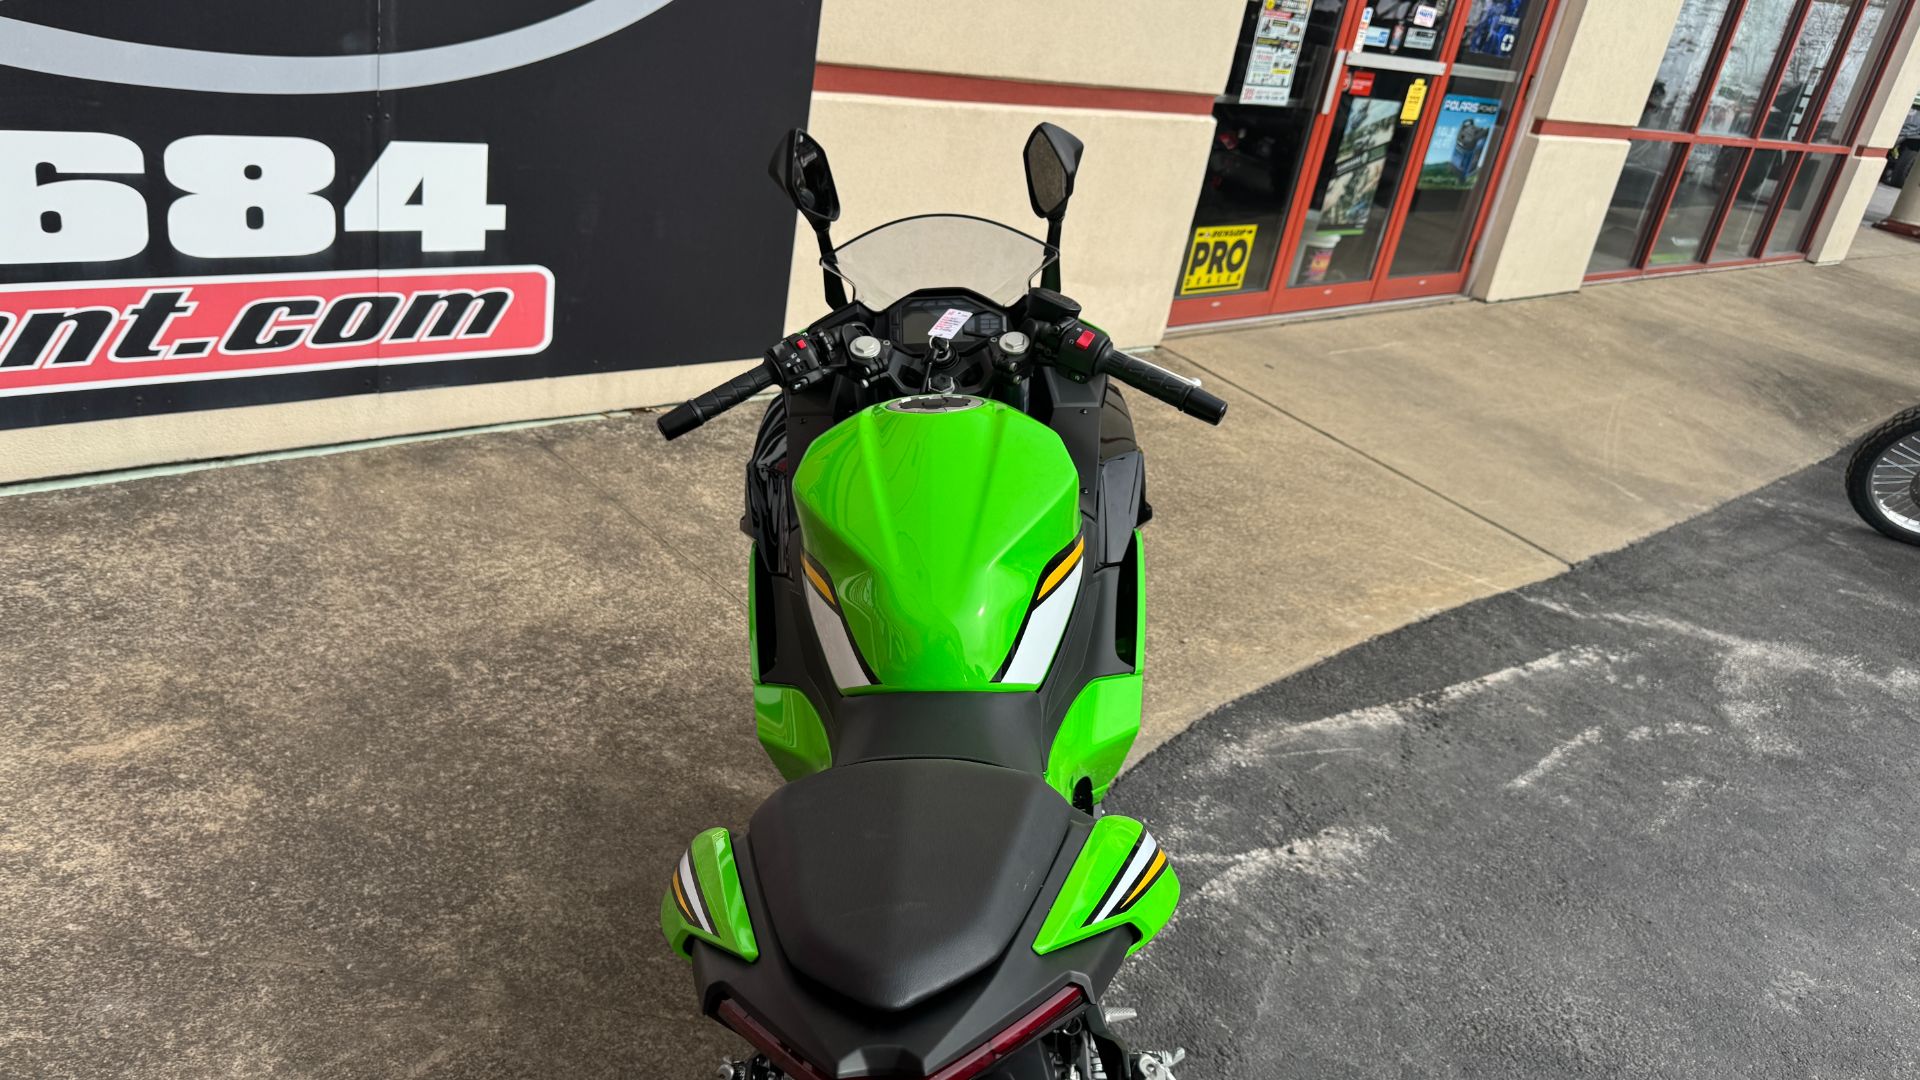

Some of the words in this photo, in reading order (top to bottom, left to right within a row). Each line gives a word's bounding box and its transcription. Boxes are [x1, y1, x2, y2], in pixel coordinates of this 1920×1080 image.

[1443, 100, 1480, 113] POLARIS
[0, 130, 506, 264] 684
[1189, 240, 1248, 276] PRO
[0, 287, 514, 370] nt.com
